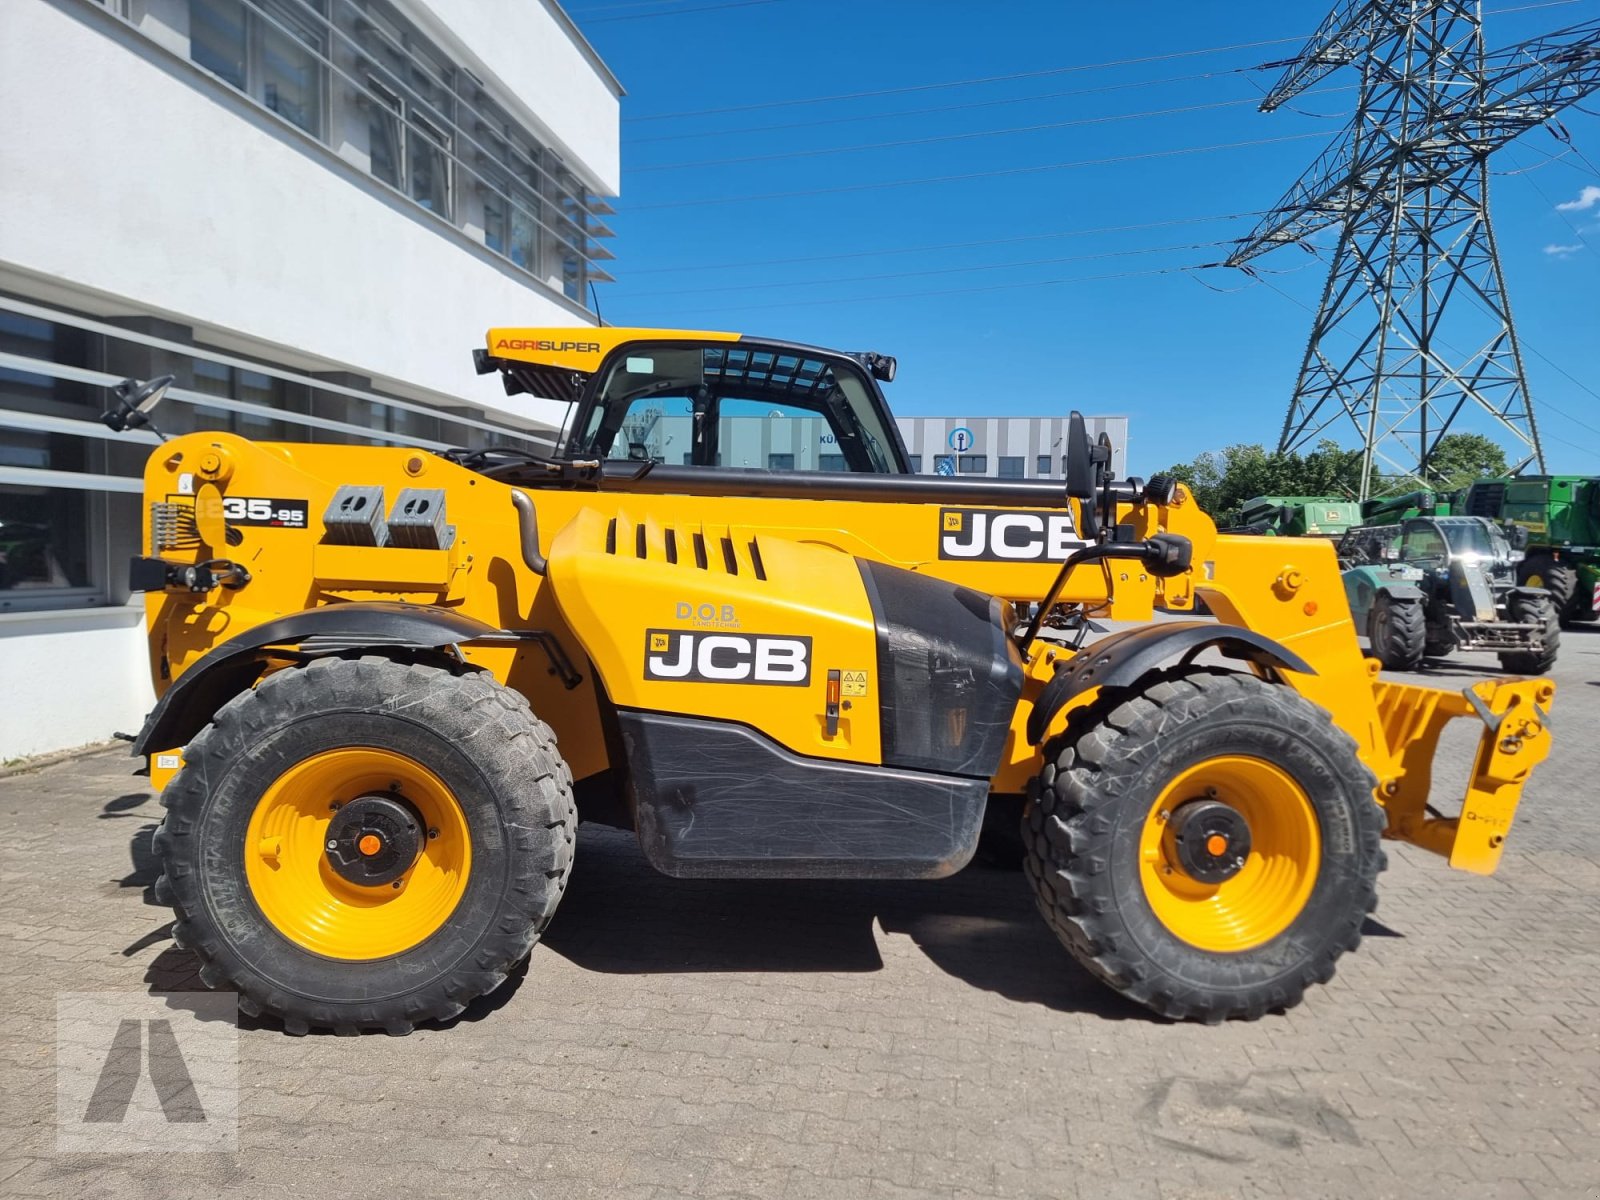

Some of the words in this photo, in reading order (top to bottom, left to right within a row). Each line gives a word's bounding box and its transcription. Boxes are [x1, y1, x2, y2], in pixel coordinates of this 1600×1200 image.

[496, 339, 600, 352] AGRISUPER
[221, 498, 304, 521] 35-95
[676, 602, 739, 622] D.O.B.
[649, 634, 807, 682] JCB
